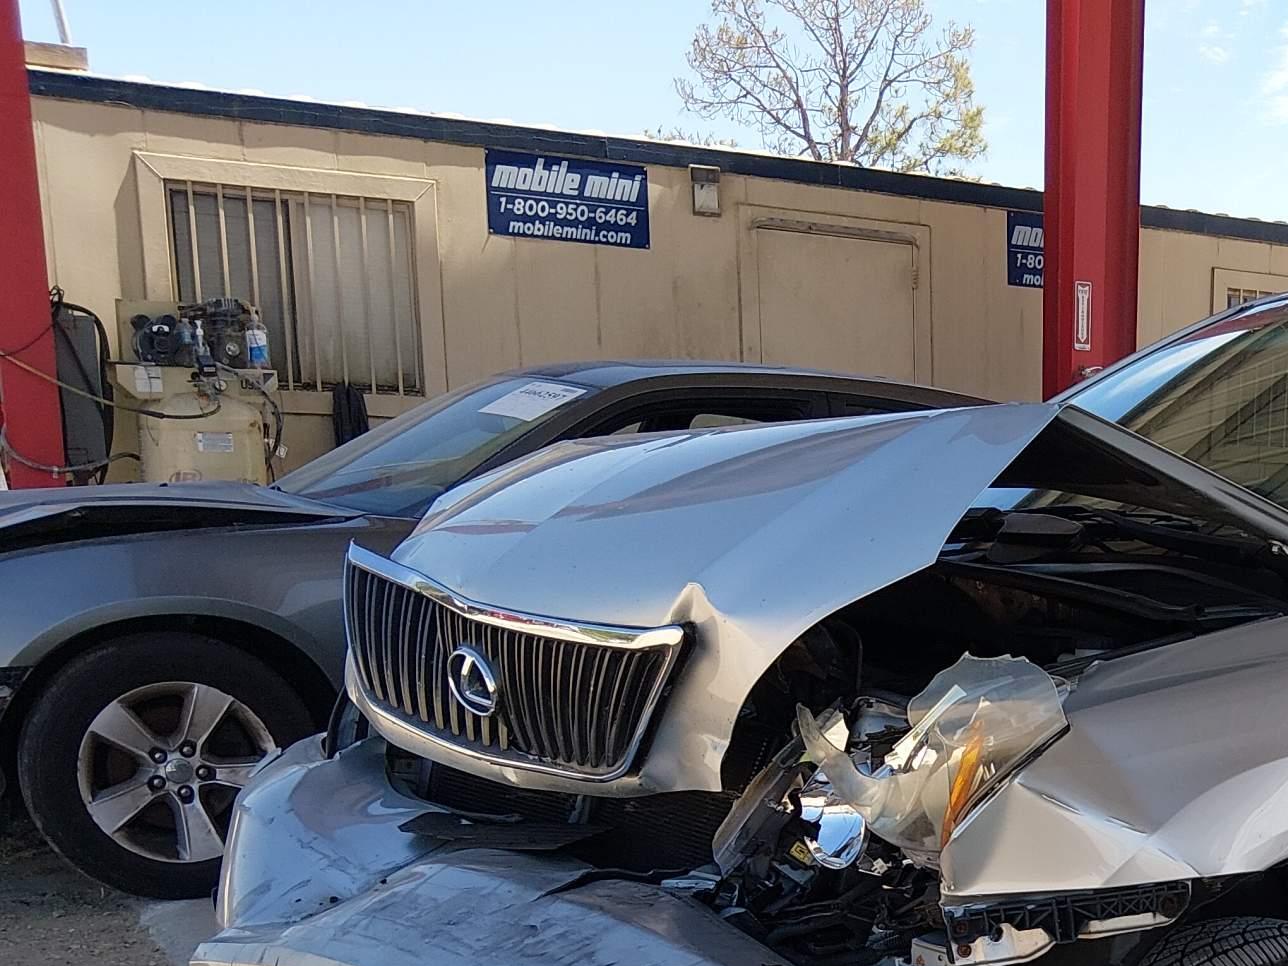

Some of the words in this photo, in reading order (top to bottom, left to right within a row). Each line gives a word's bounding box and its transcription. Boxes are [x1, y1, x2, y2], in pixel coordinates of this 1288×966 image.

[491, 157, 580, 196] mobile
[583, 172, 642, 202] mini
[499, 197, 638, 227] 1-800-950-6464
[508, 219, 632, 245] mobilemini.com
